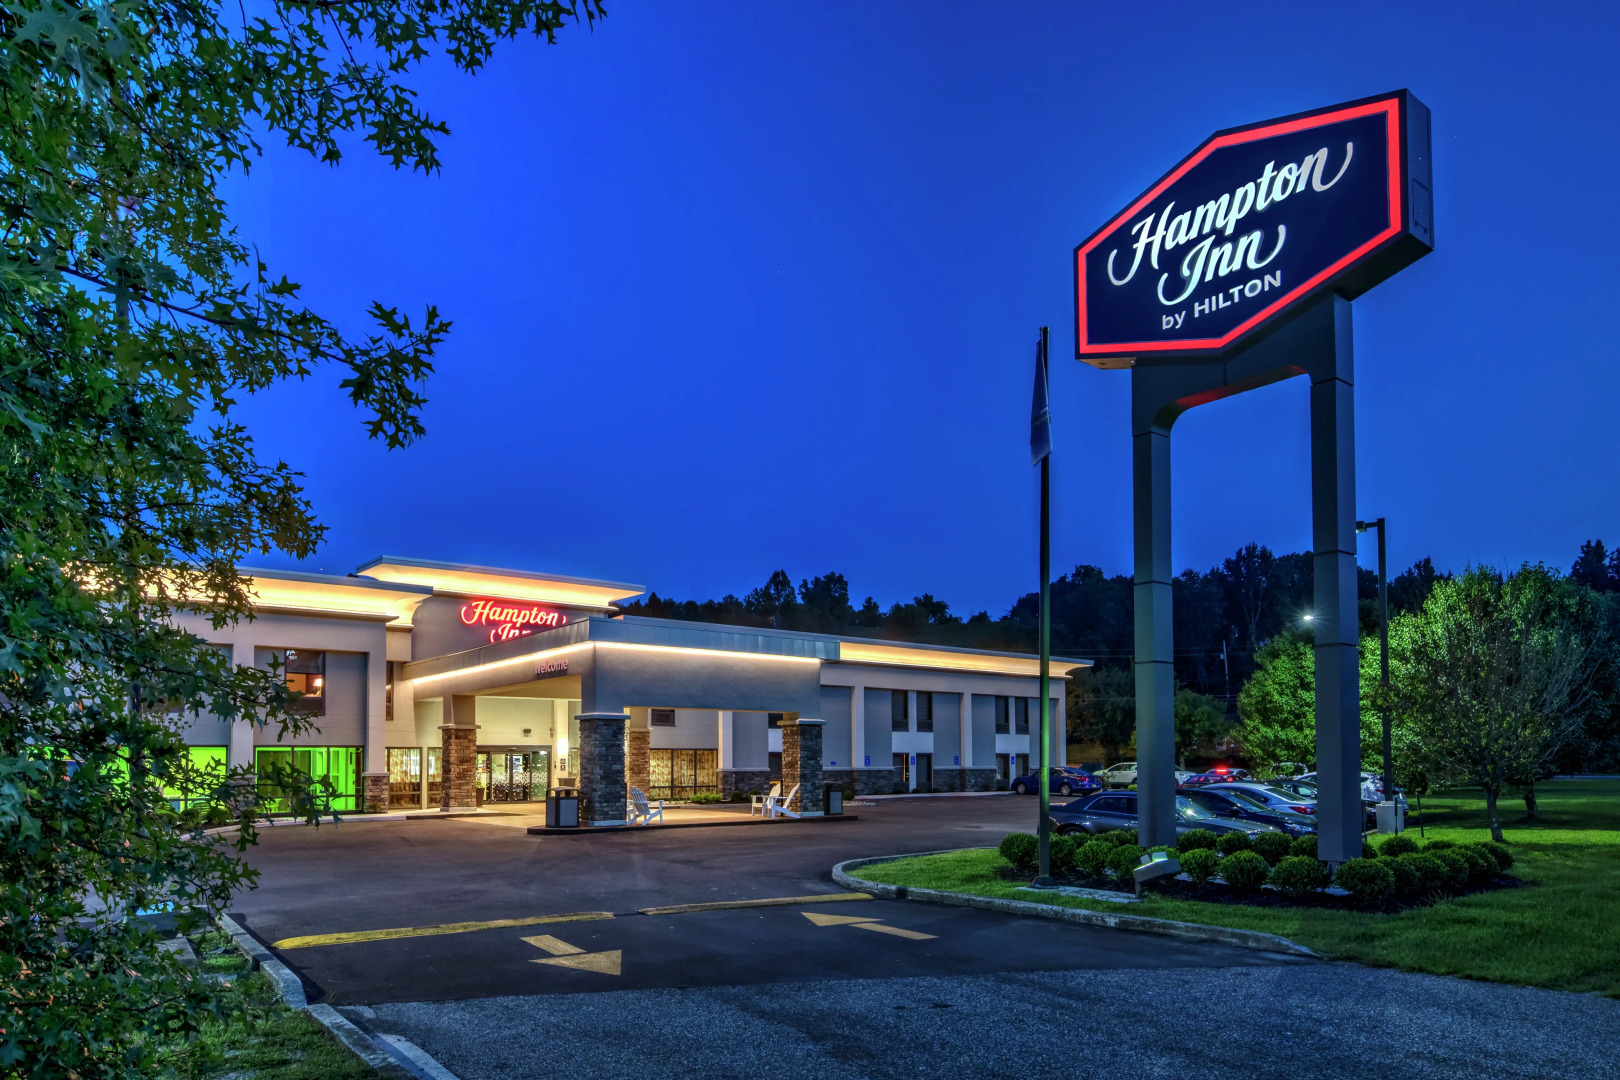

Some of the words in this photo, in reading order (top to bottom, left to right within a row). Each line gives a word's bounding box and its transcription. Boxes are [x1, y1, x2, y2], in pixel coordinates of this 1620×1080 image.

[1107, 141, 1354, 286] Hampton
[1157, 224, 1287, 306] Inn
[1161, 309, 1186, 330] by
[1193, 270, 1282, 318] HILTON
[461, 600, 567, 627] Hampton
[534, 659, 569, 675] welcome
